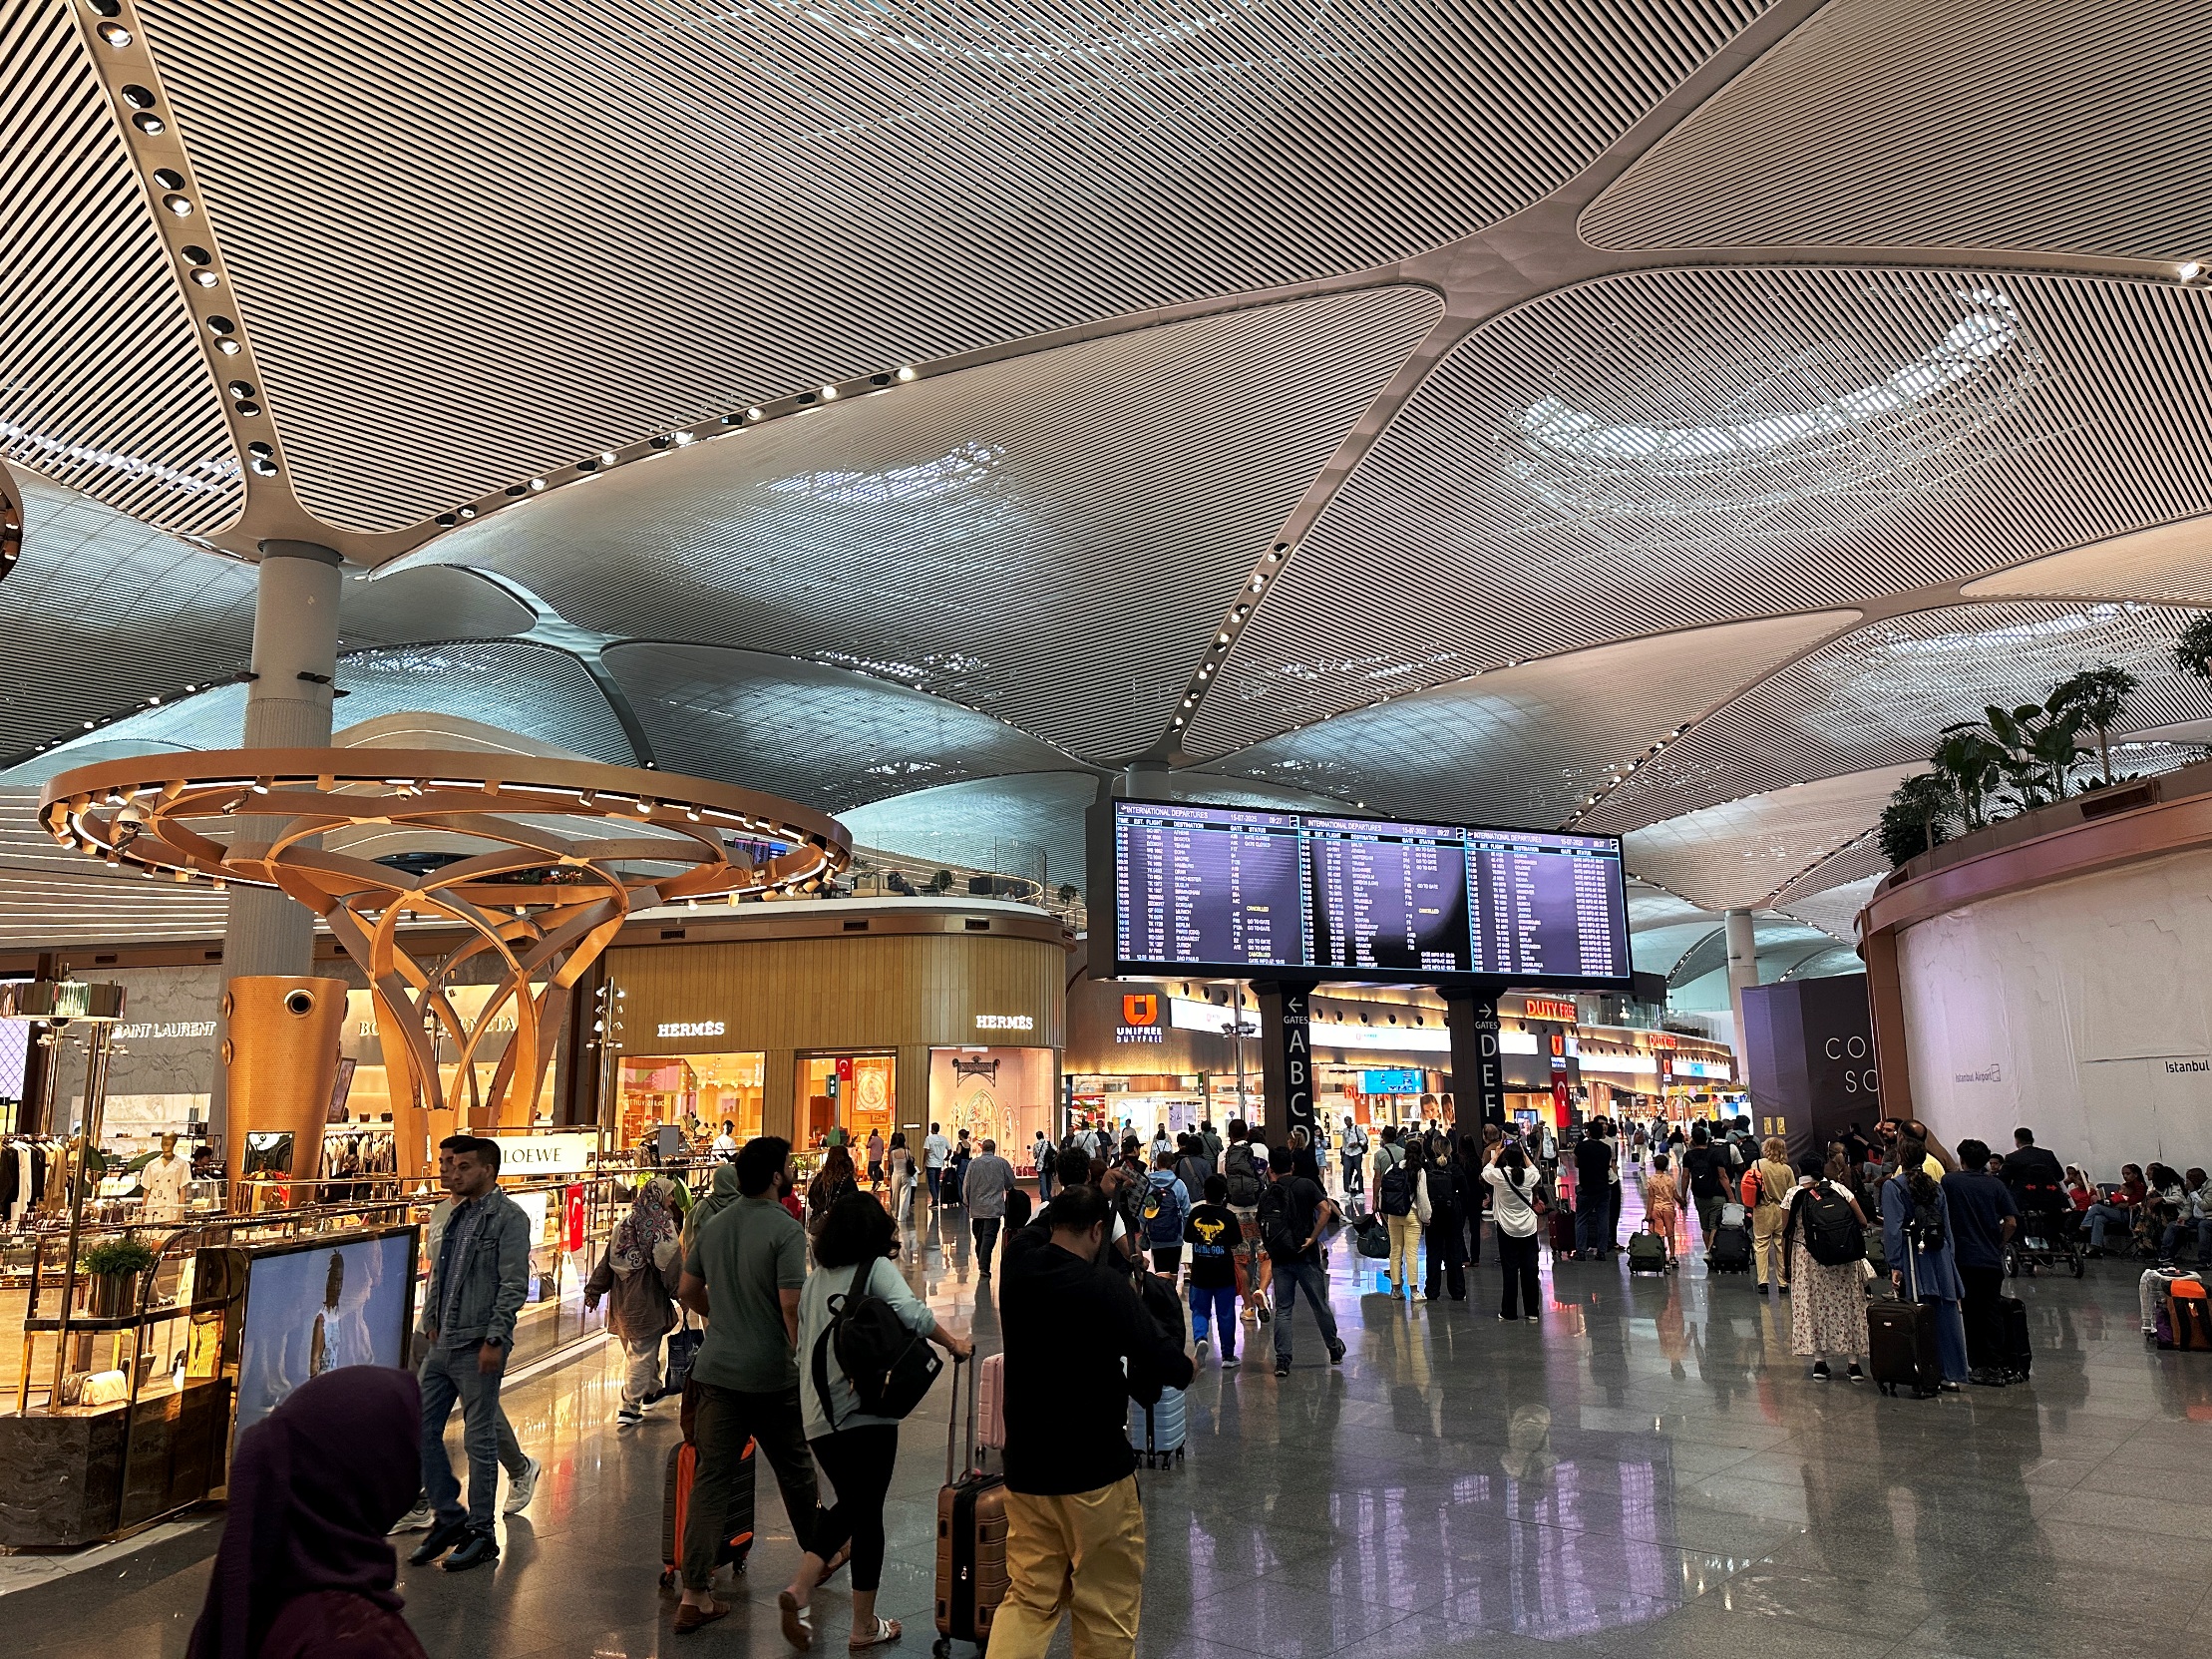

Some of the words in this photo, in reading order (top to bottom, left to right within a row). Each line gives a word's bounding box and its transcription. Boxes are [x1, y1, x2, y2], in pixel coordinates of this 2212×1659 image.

[1127, 806, 1170, 816] INTERNATIONAL
[1172, 809, 1208, 818] DEPARTURES
[1308, 820, 1347, 829] INTERNATIONAL
[1474, 832, 1510, 841] INTERNATIONAL
[1526, 1001, 1558, 1018] DUTY
[1560, 1004, 1576, 1020] FREE
[1284, 1016, 1308, 1025] GATES
[1475, 1021, 1498, 1030] GATES
[113, 1024, 152, 1037] SAINT
[154, 1022, 216, 1037] LAURENT
[1289, 1030, 1305, 1053] A
[1481, 1035, 1496, 1056] D
[1650, 1035, 1667, 1047] DUTY
[1290, 1061, 1304, 1084] B
[2165, 1059, 2210, 1072] Istanbul
[1483, 1064, 1495, 1086] E
[1956, 1073, 1975, 1082] Istanbul
[1976, 1071, 1992, 1082] Airport
[1290, 1092, 1306, 1116] C
[1485, 1094, 1495, 1116] F
[504, 1148, 561, 1163] LOEWE
